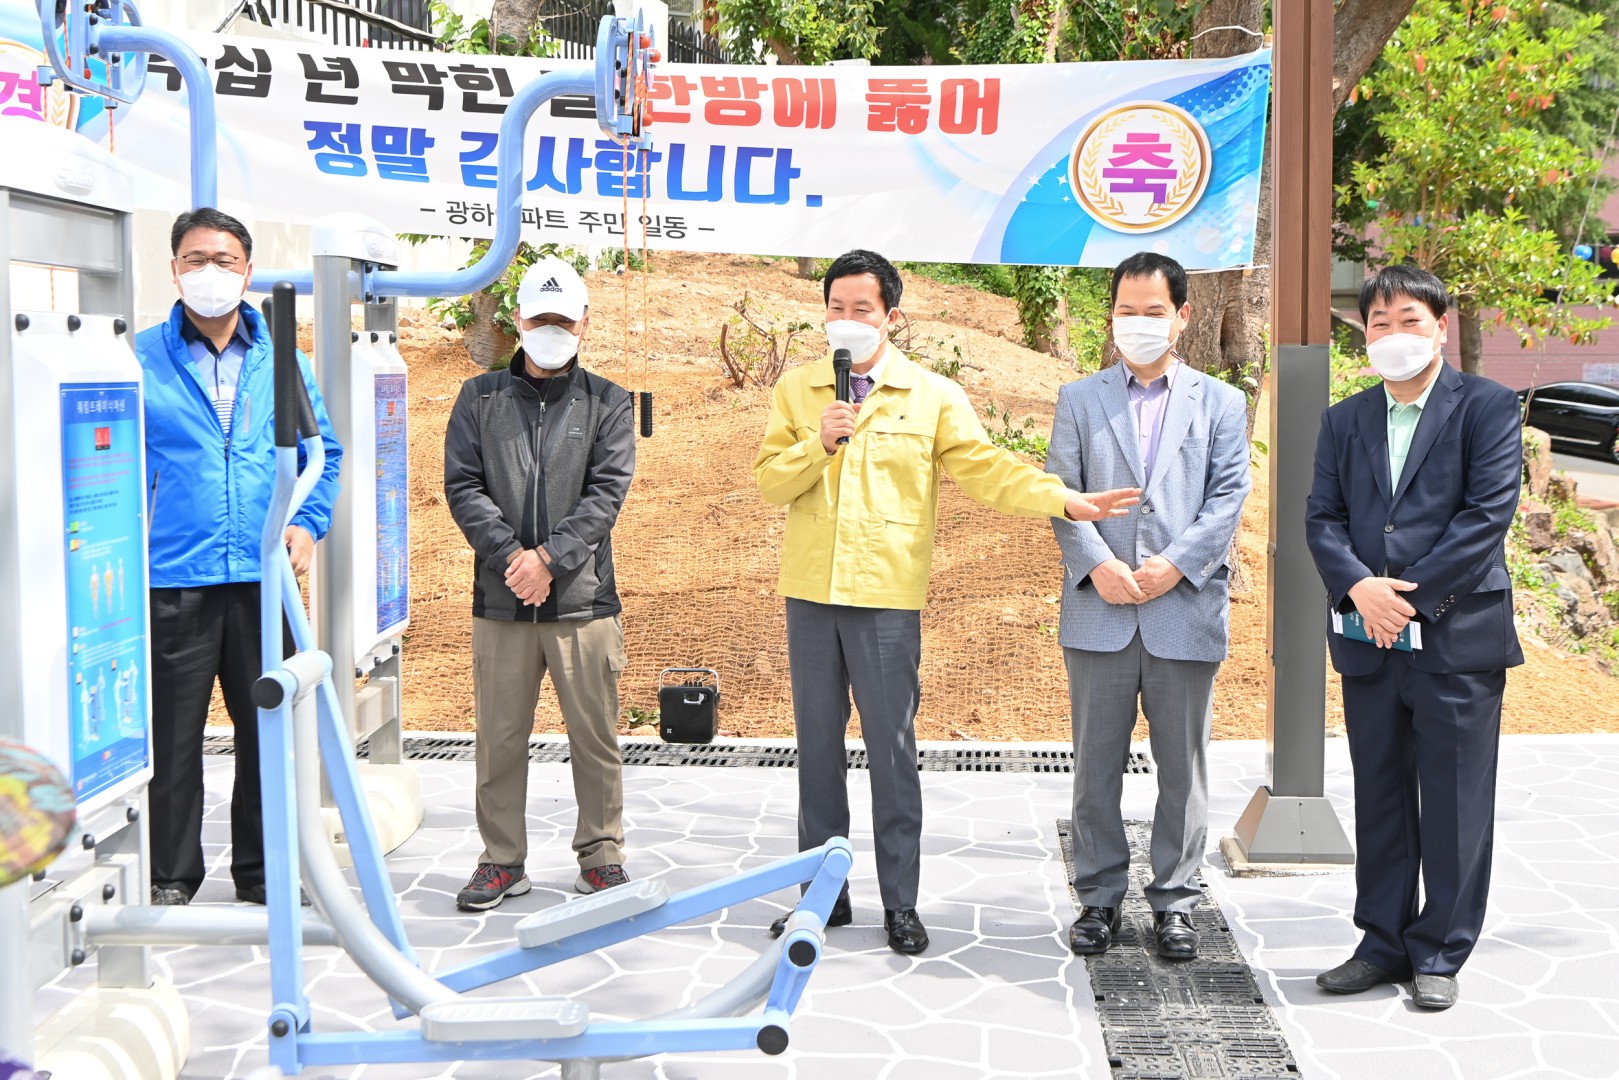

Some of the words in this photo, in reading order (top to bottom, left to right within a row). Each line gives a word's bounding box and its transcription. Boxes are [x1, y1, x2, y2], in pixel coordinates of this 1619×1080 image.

[297, 53, 359, 105] 년
[382, 61, 514, 114] 막힌
[647, 74, 836, 130] 한방에
[865, 78, 1000, 135] 뚫어
[304, 121, 435, 183] 정말
[1102, 133, 1177, 204] 축
[446, 201, 568, 230] 광하파트
[578, 210, 626, 236] 주민
[639, 214, 688, 239] 일동
[540, 285, 563, 293] adidas
